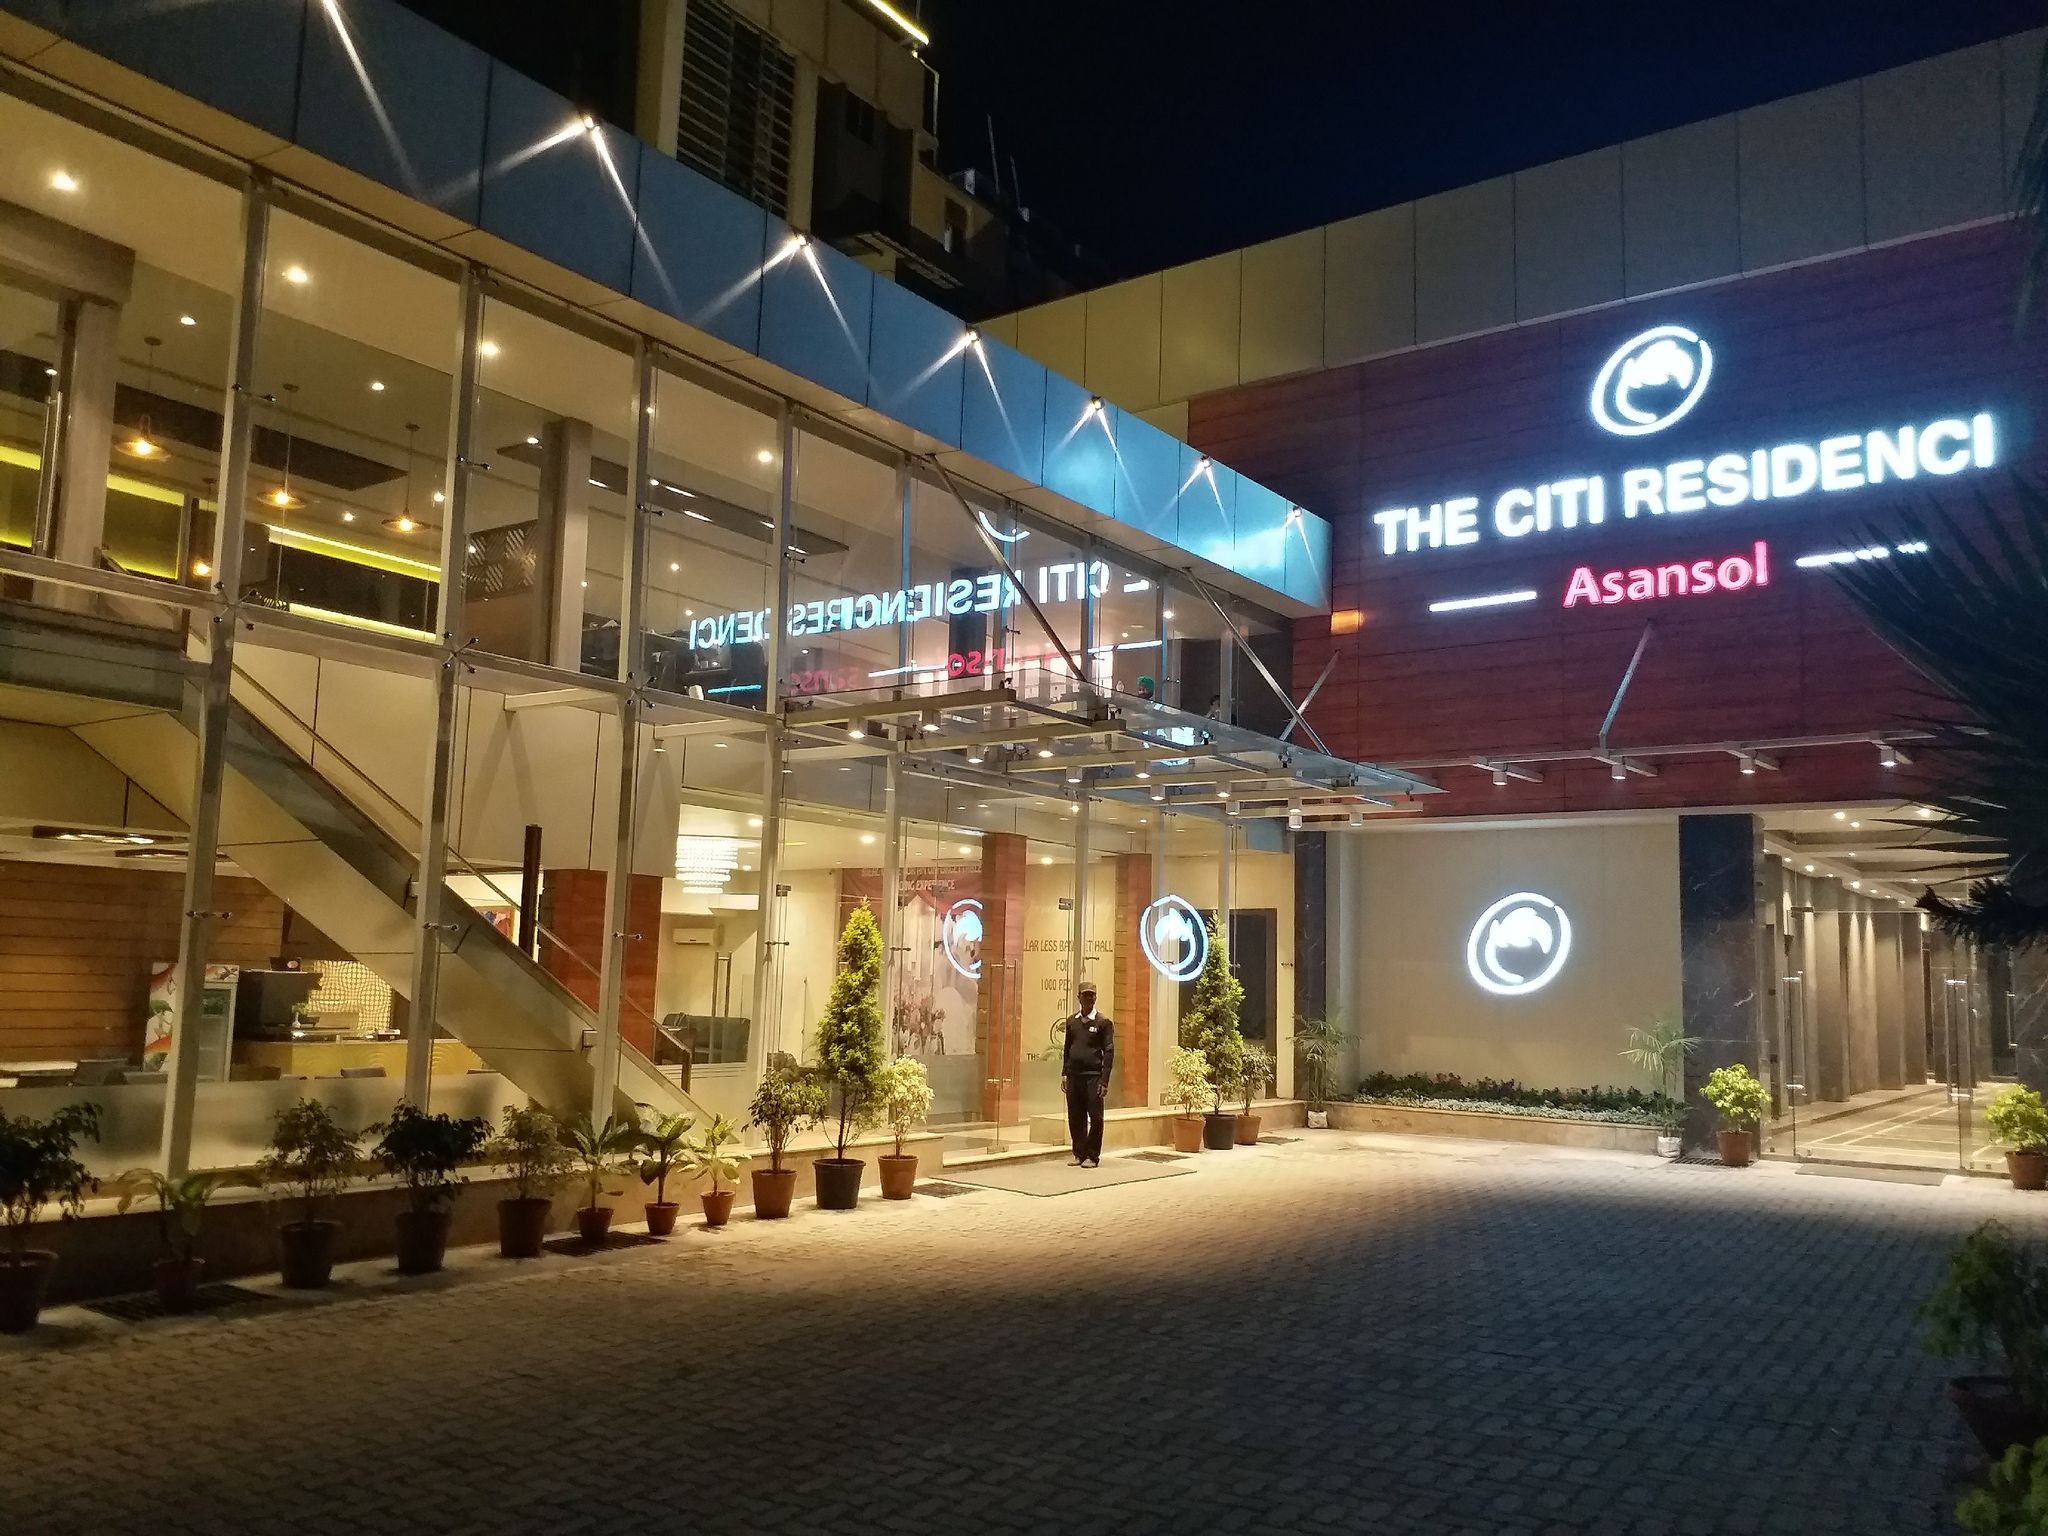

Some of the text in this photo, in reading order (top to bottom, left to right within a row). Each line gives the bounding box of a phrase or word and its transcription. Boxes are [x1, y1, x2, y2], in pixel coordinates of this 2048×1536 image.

[1373, 412, 1998, 556] THE CITI RESIDENCI
[1561, 538, 1770, 609] Asansol
[916, 880, 955, 891] EXPERENCE
[1040, 940, 1058, 952] LESS
[1094, 940, 1113, 952] HALL
[1041, 979, 1057, 990] 1000
